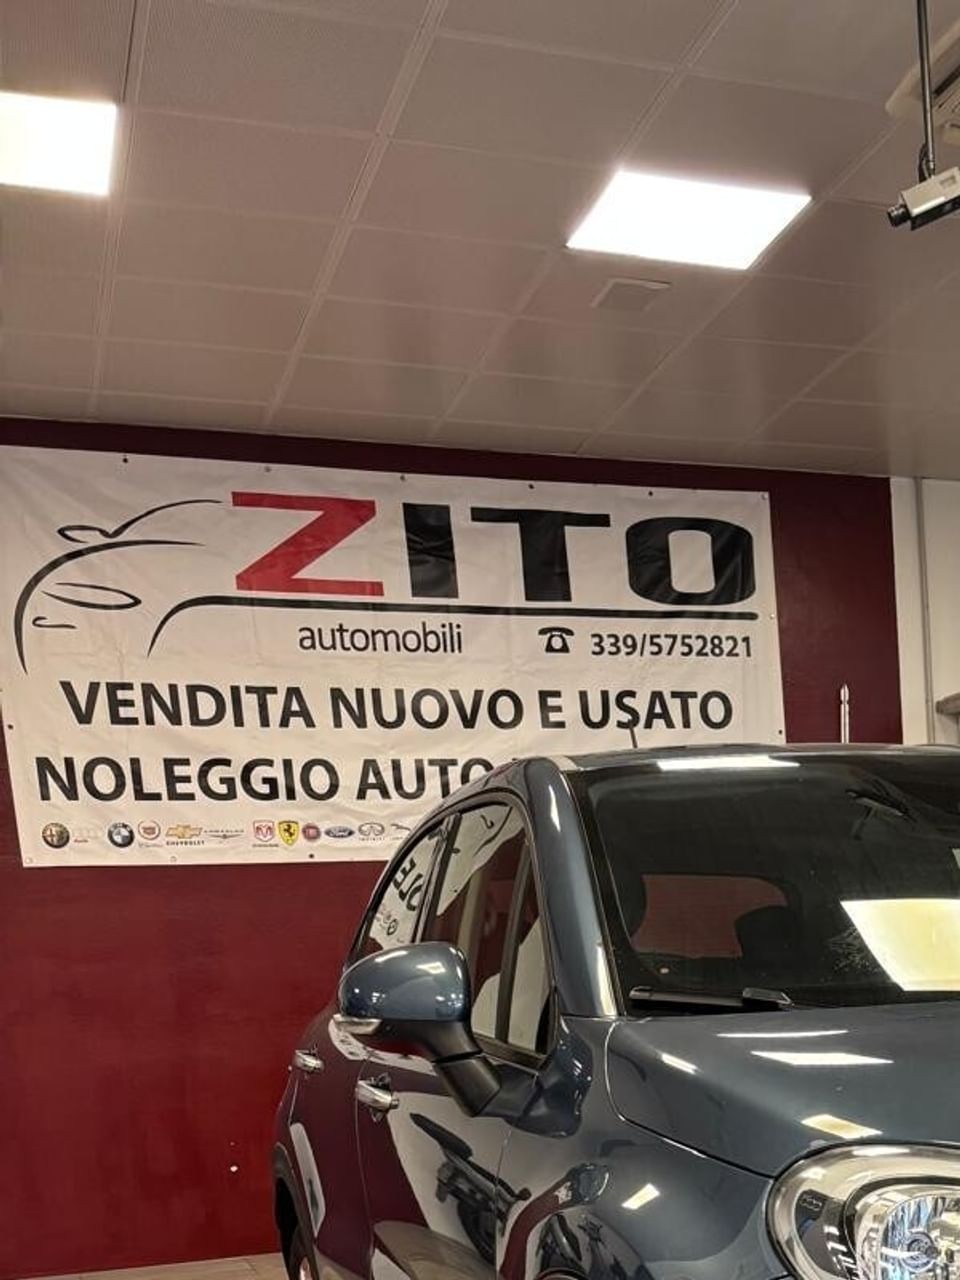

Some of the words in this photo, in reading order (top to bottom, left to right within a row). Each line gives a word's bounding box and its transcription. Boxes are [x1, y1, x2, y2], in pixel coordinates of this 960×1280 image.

[232, 491, 756, 606] ZITO
[299, 622, 463, 654] automobili
[591, 633, 752, 658] 339/5752821
[59, 680, 316, 728] VENDITA
[330, 687, 524, 729] NUOVO
[538, 689, 566, 729] E
[579, 689, 733, 729] USATO
[35, 756, 339, 801] NOLEGGIO
